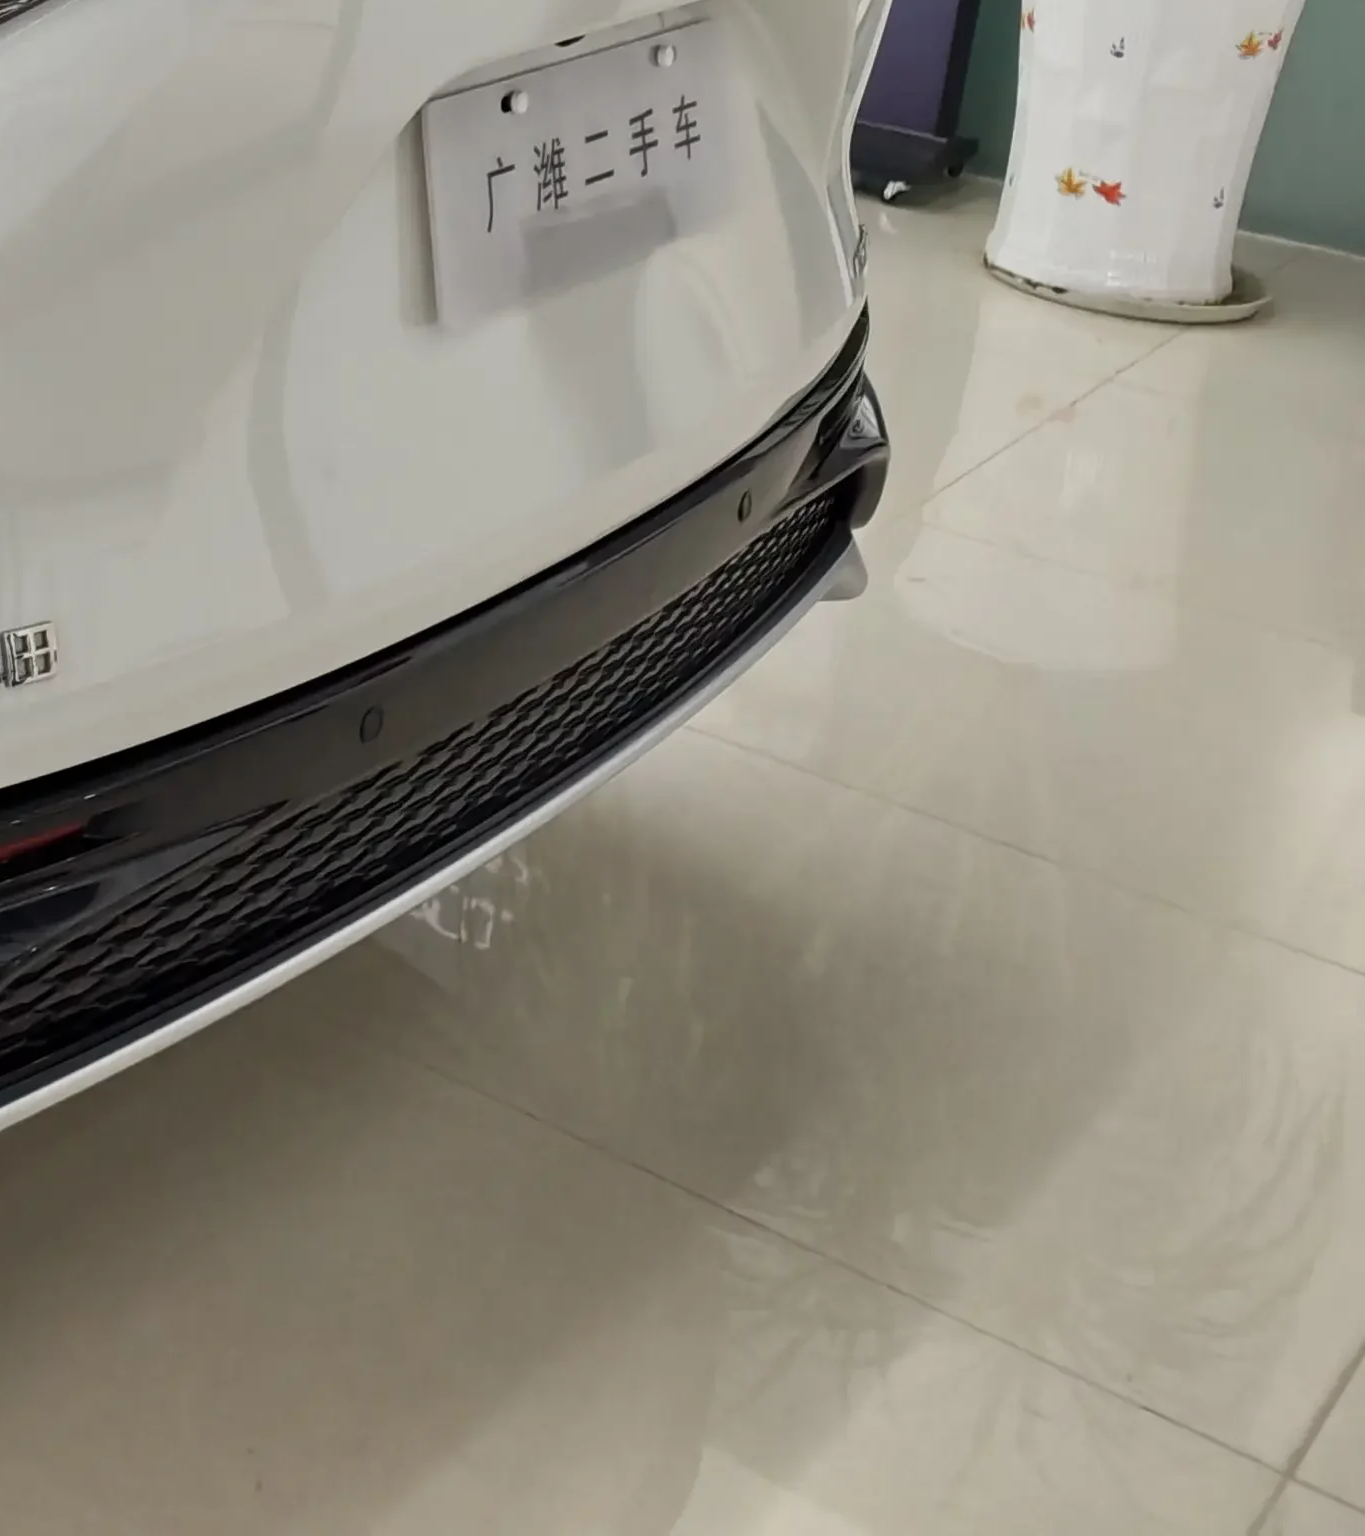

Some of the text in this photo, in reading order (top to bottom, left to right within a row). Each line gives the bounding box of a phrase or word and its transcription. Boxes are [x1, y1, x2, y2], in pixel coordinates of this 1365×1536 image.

[486, 95, 701, 233] 广潍二手车
